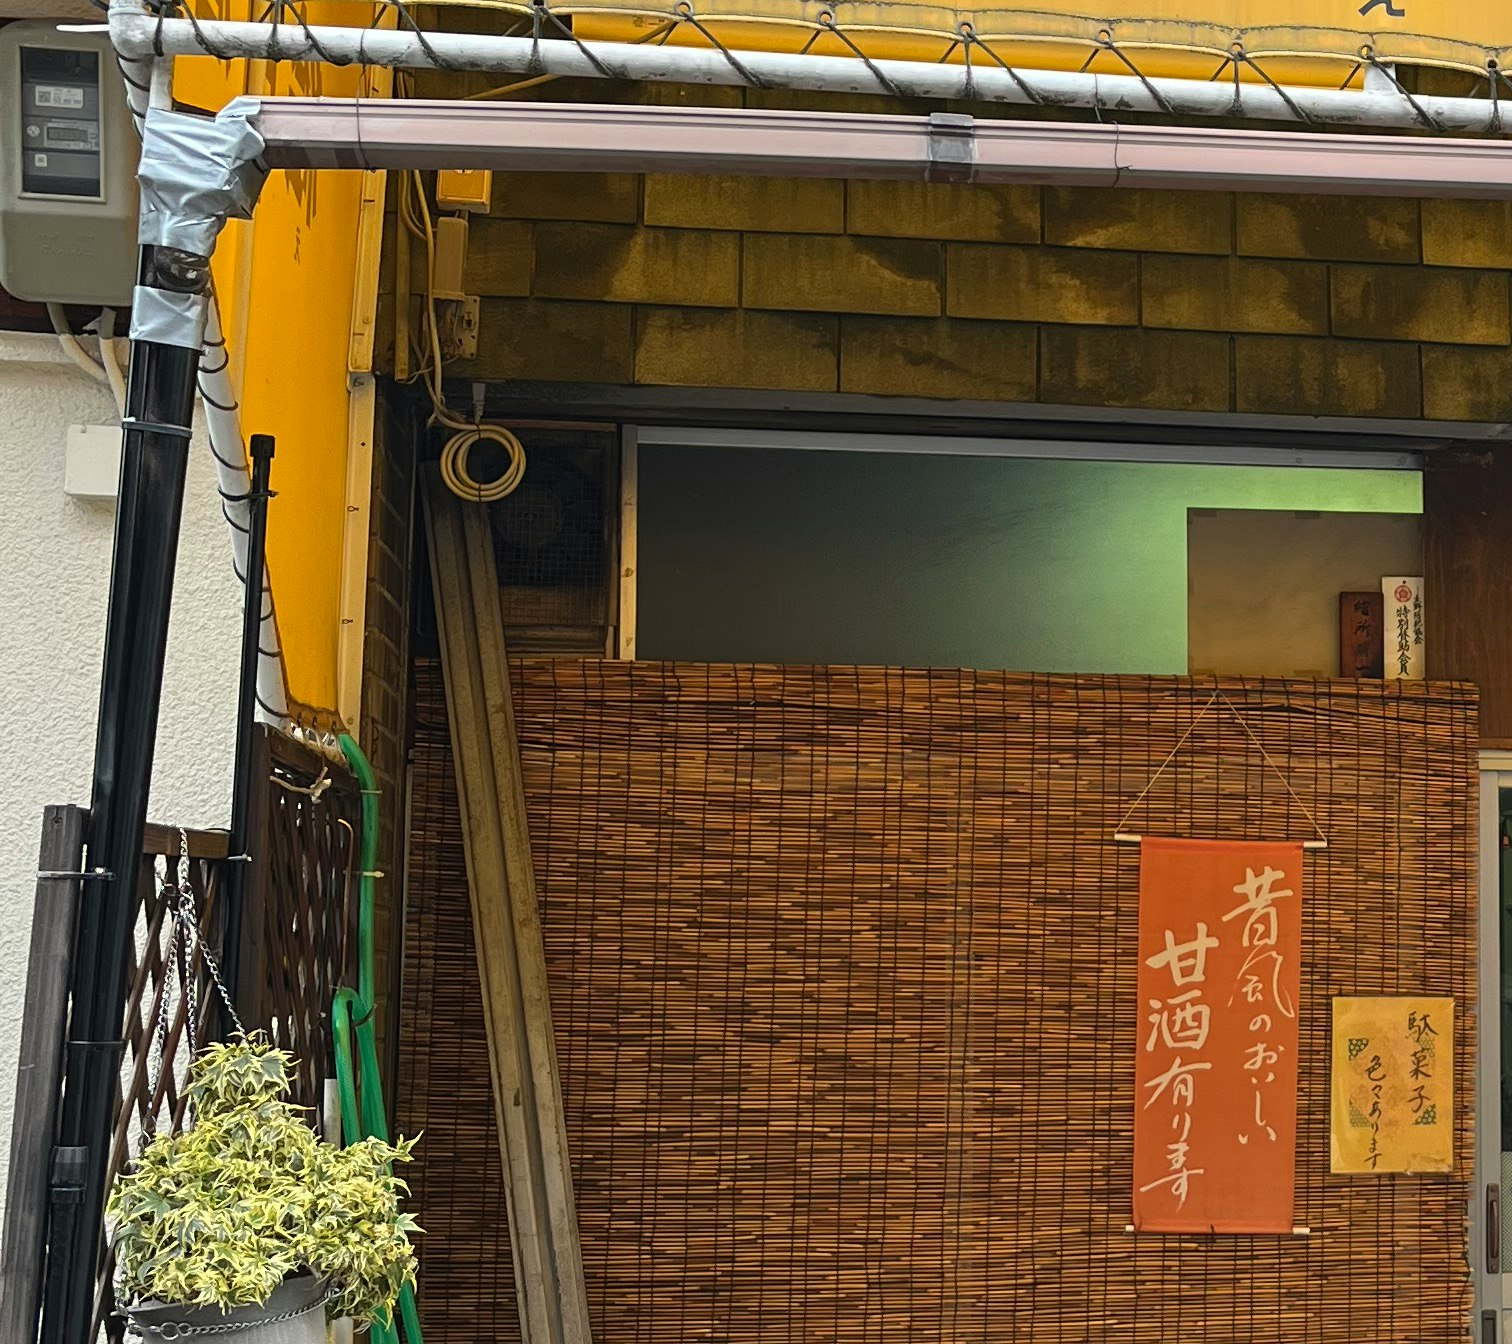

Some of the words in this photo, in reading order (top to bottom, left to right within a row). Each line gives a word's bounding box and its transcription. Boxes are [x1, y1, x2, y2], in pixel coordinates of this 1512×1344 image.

[1139, 921, 1219, 1213] 甘酒有ります
[1221, 865, 1295, 1145] 昔風のおいしい
[1406, 1010, 1440, 1114] 駄菓子
[1363, 1054, 1388, 1170] 色々あります
